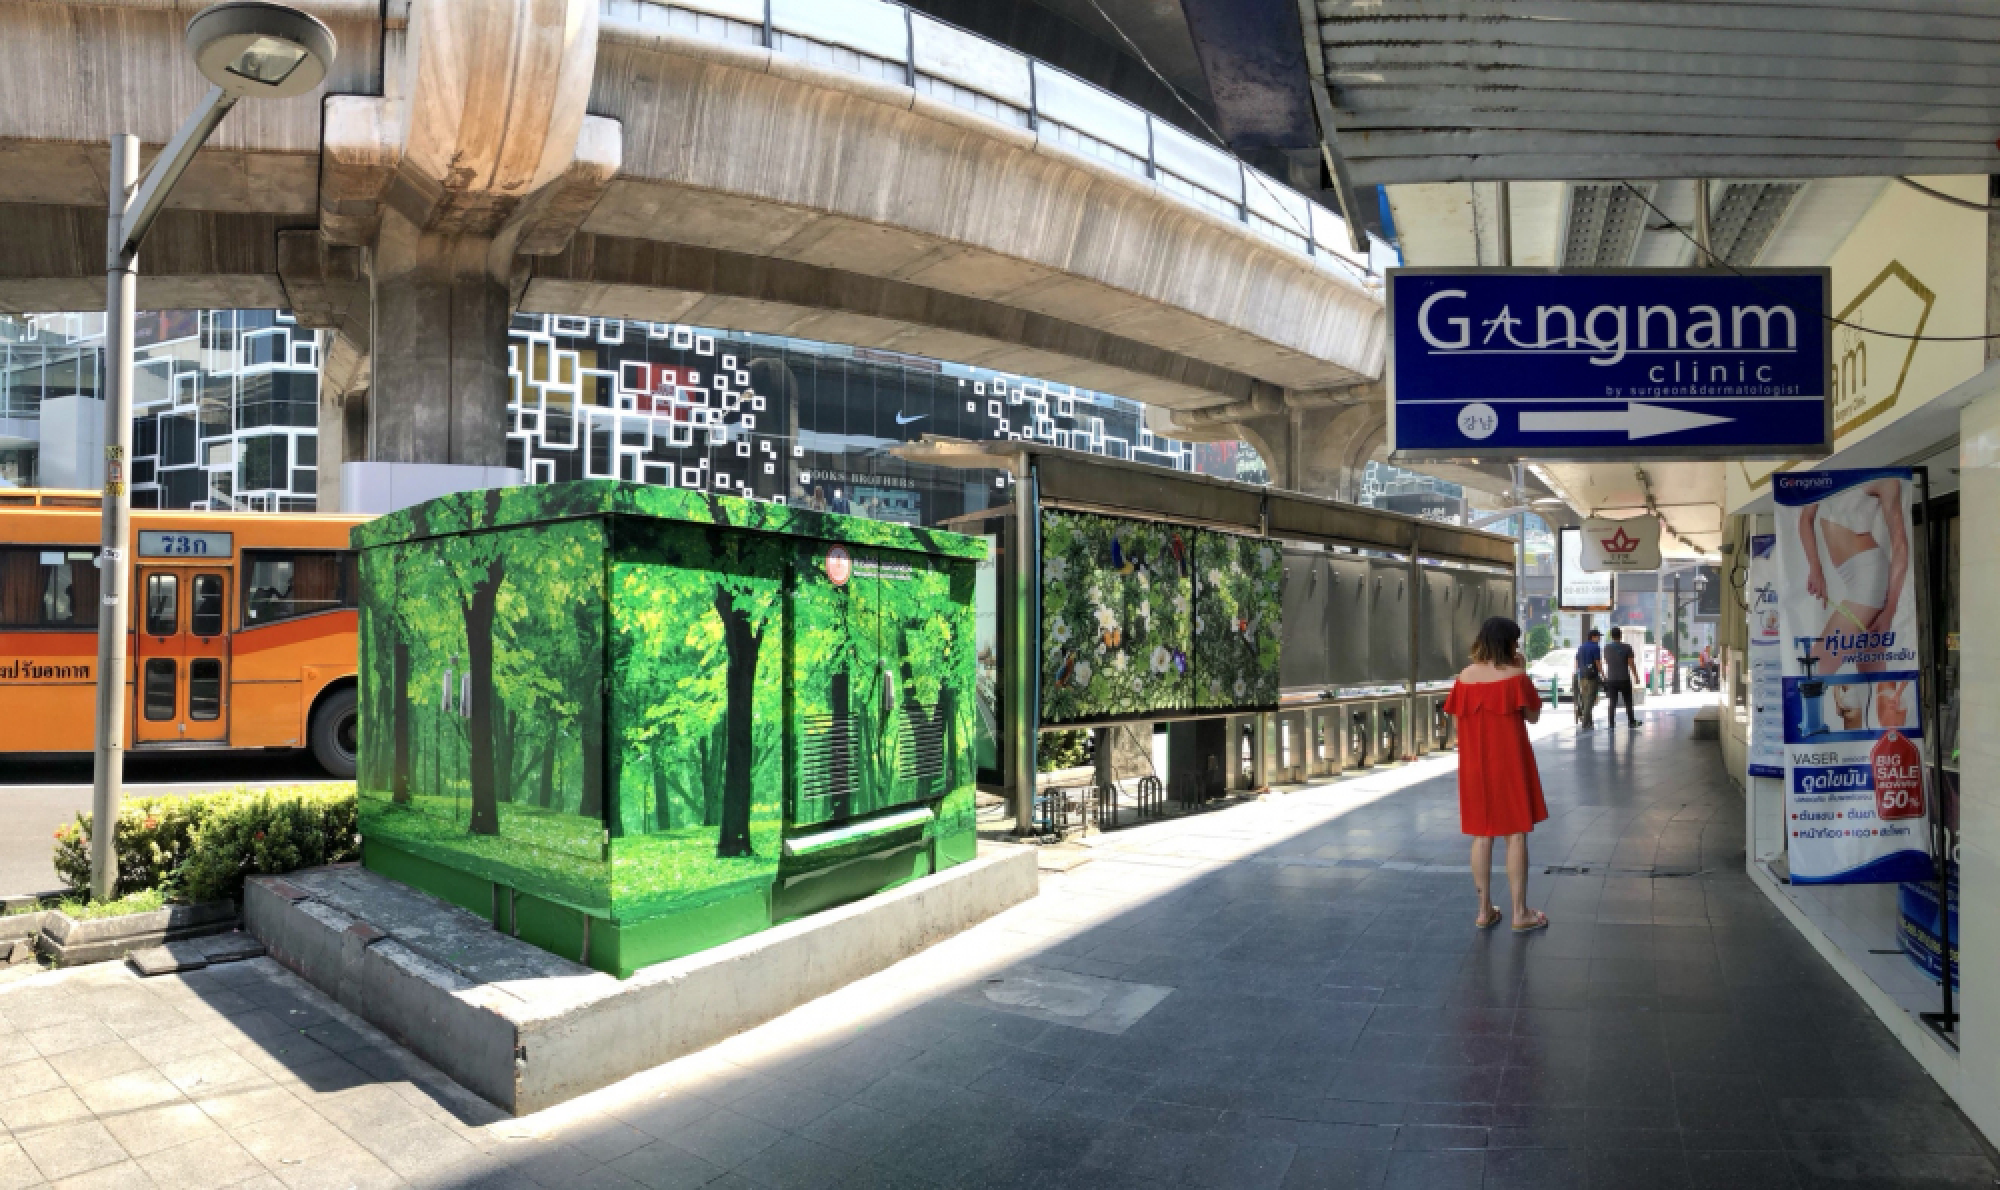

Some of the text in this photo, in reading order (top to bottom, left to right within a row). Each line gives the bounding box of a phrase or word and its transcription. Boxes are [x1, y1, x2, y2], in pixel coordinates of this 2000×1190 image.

[1649, 360, 1773, 383] clinic
[1606, 384, 1622, 398] by
[161, 536, 207, 554] 73ก
[1825, 630, 1897, 657] หุ่นสวย
[1792, 752, 1839, 765] VASER
[1877, 754, 1901, 766] BIG
[1878, 765, 1919, 779] SALE
[1802, 769, 1868, 793] ดูดไขมัน
